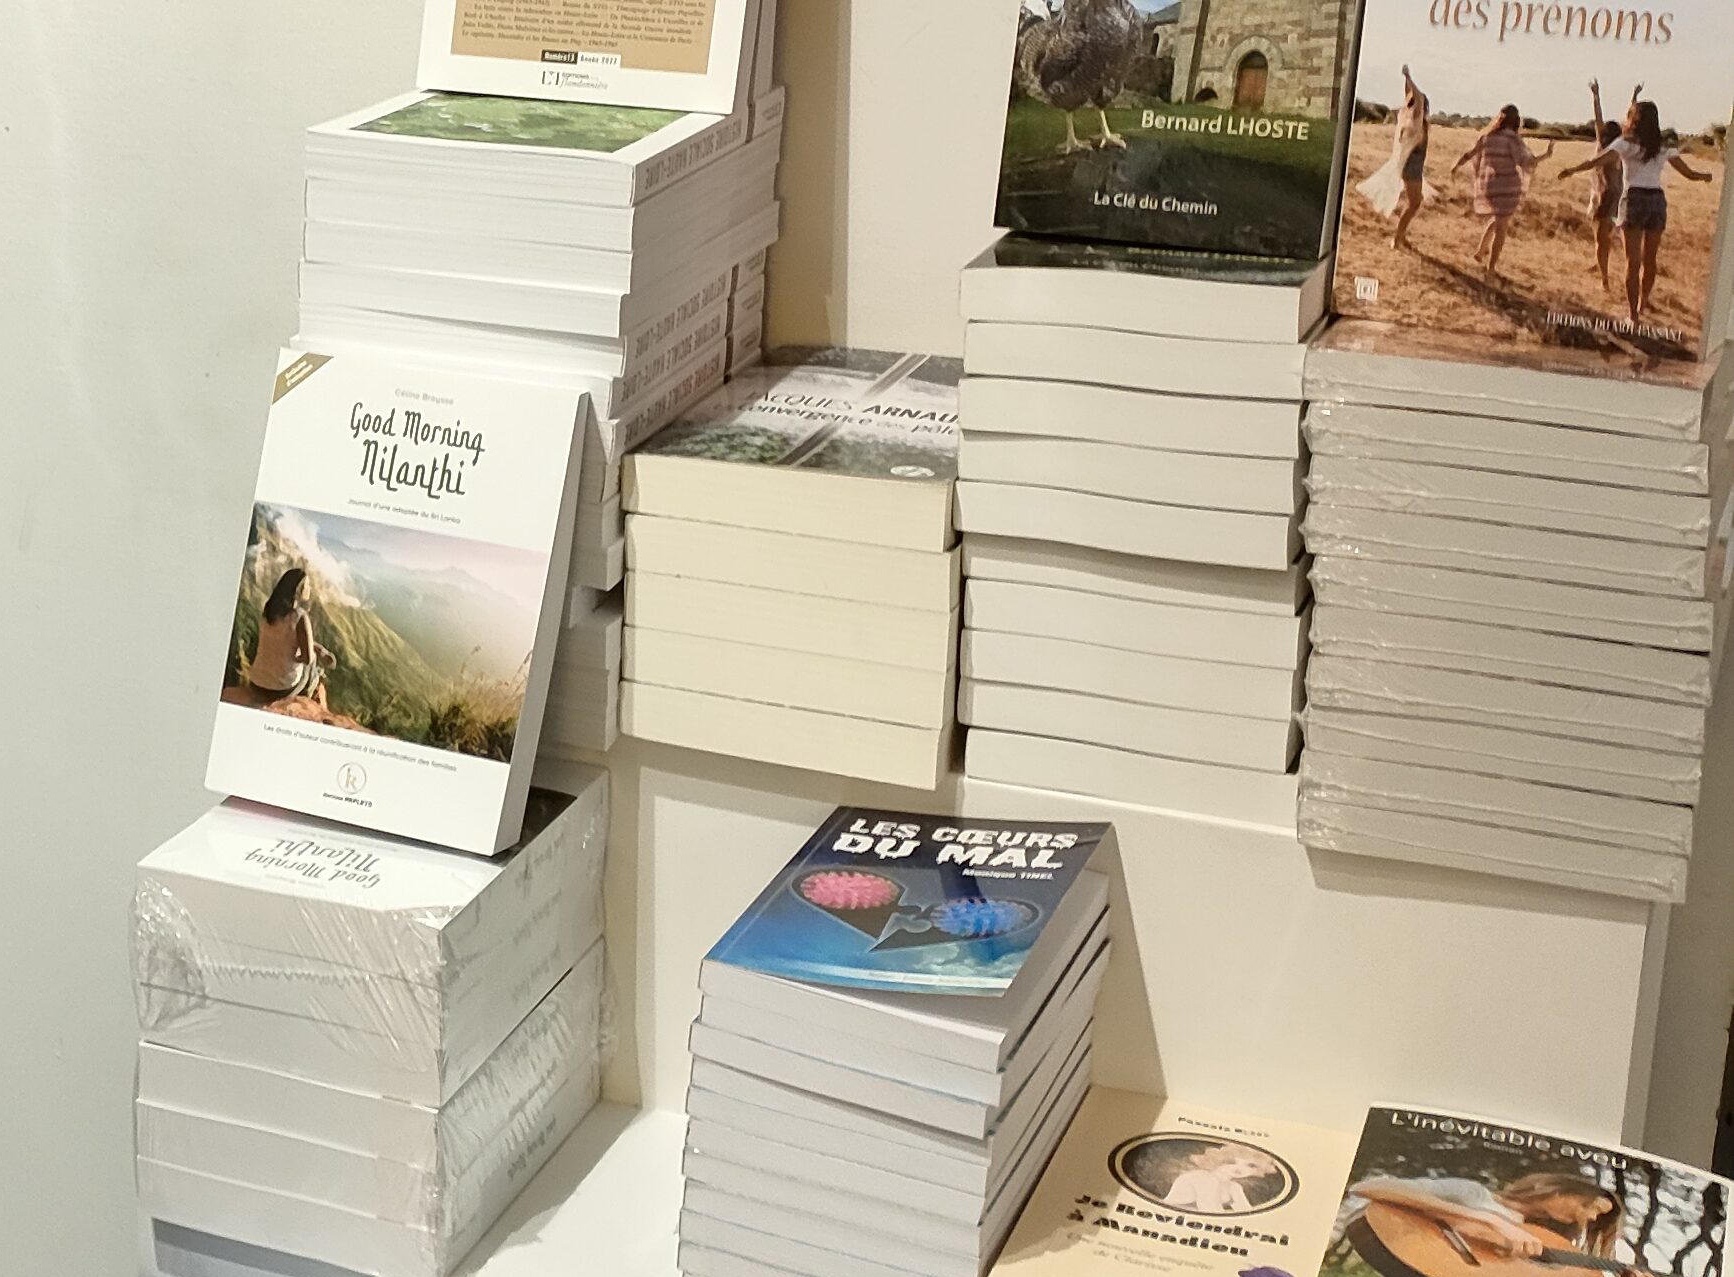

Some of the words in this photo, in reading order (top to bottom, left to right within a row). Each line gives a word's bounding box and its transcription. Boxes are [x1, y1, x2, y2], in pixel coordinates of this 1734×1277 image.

[1428, 0, 1490, 29] des
[1498, 0, 1674, 44] prénoms
[1141, 109, 1222, 134] Bernard
[1226, 115, 1310, 141] LHOSTE
[1094, 192, 1110, 206] La
[1113, 192, 1136, 209] Clé
[1139, 194, 1158, 210] du
[1162, 196, 1218, 216] Chemin
[350, 402, 396, 439] Good
[403, 410, 485, 467] Morning
[361, 439, 465, 500] Nilanthi
[849, 817, 921, 841] LES
[244, 848, 326, 879] Morning
[270, 838, 381, 872] Nilanthi
[831, 831, 921, 860] DU
[936, 843, 1065, 870] MAL
[328, 870, 381, 889] Good
[1391, 1111, 1551, 1153] L'inévitable
[1559, 1134, 1628, 1171] aveu
[1116, 1203, 1290, 1246] Reviendrai
